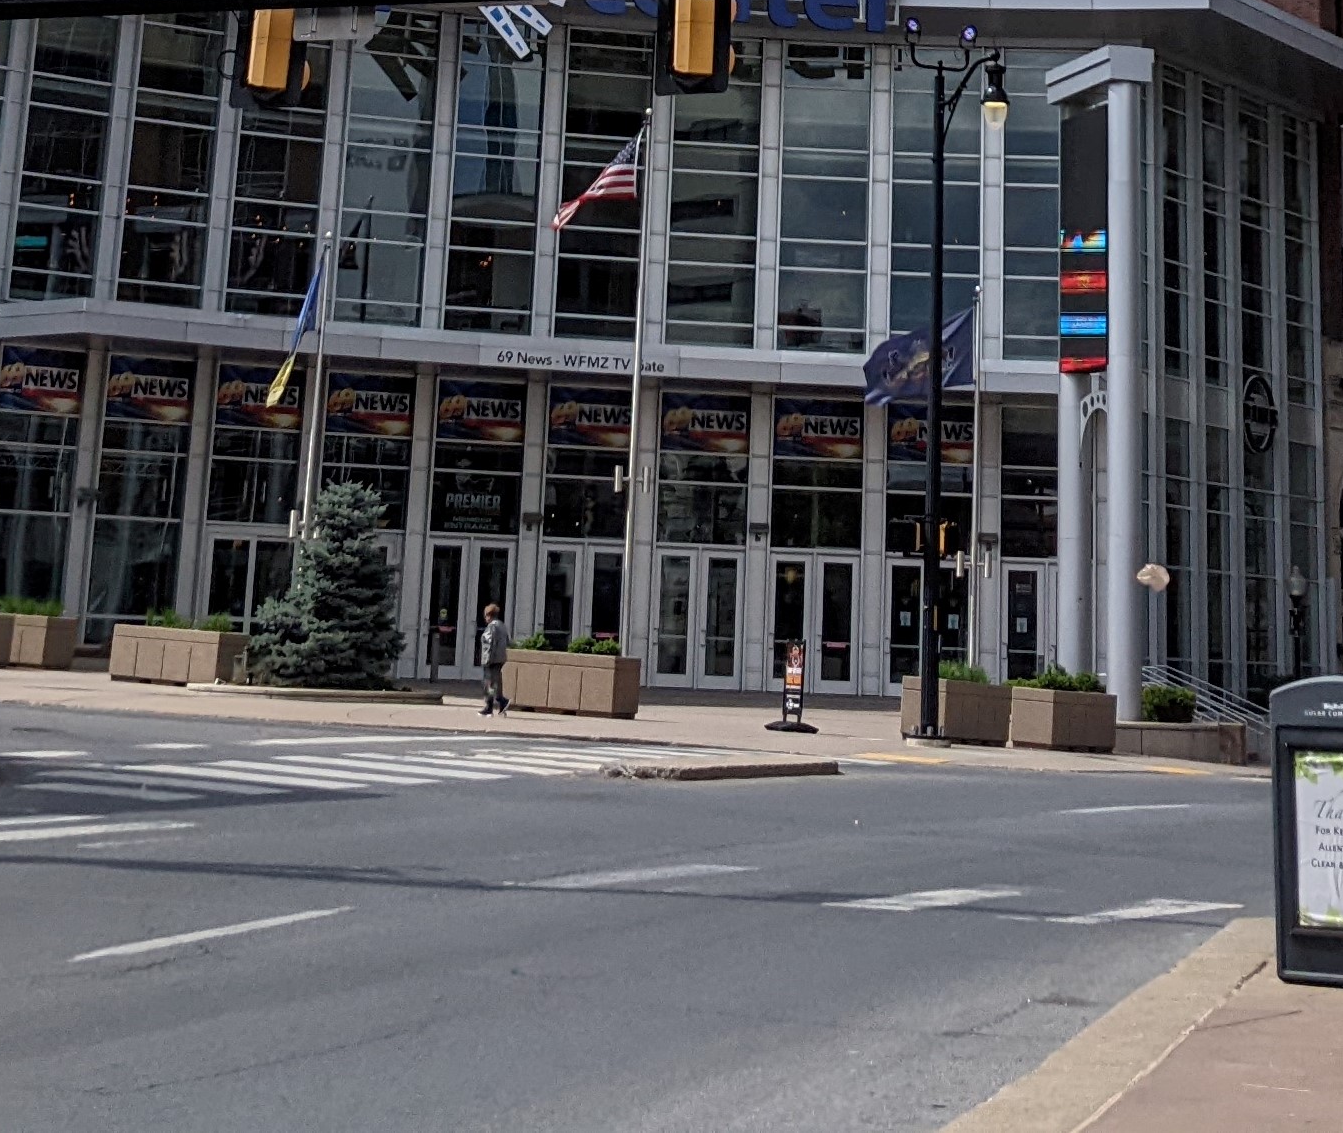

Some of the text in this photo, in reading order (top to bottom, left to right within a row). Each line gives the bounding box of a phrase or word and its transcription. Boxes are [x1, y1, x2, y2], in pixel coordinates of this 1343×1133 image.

[497, 350, 514, 363] 69
[517, 352, 553, 366] News
[563, 354, 609, 369] WFMZ
[612, 357, 631, 370] TV
[24, 367, 79, 390] NEWS
[133, 376, 188, 399] NEWS
[355, 393, 410, 413] NEWS
[466, 399, 520, 419] NEWS
[691, 412, 747, 431] NEWS
[804, 418, 860, 437] NEWS
[918, 422, 974, 441] NWS
